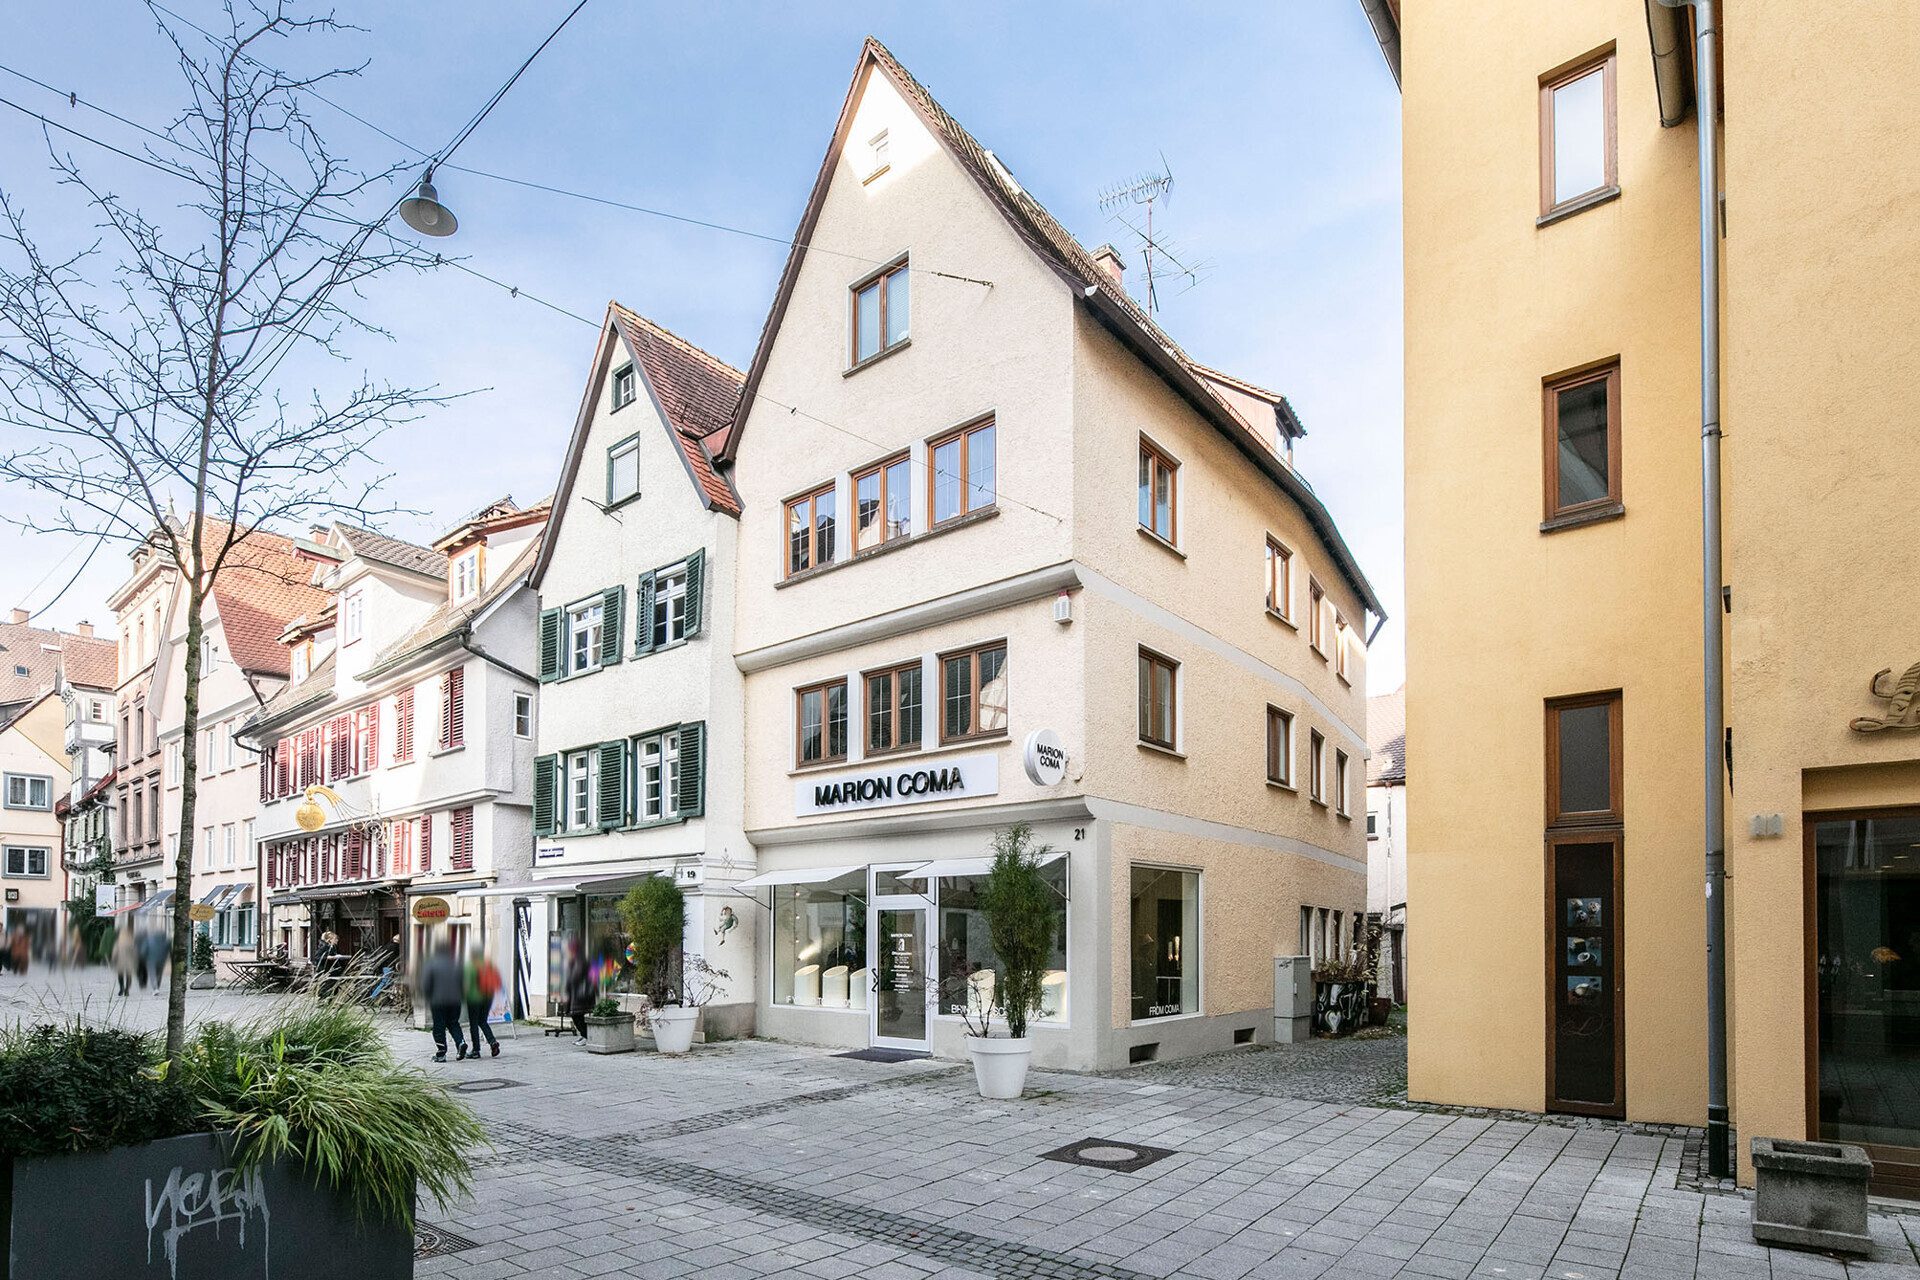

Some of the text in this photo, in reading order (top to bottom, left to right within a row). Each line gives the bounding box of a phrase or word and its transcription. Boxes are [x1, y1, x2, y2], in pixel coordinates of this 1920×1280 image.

[1036, 743, 1064, 760] MARION
[1039, 756, 1061, 770] COMA
[815, 767, 965, 807] MARION COMA
[1074, 827, 1085, 841] 21
[687, 870, 697, 880] 19
[1149, 1004, 1179, 1016] FROM COMA
